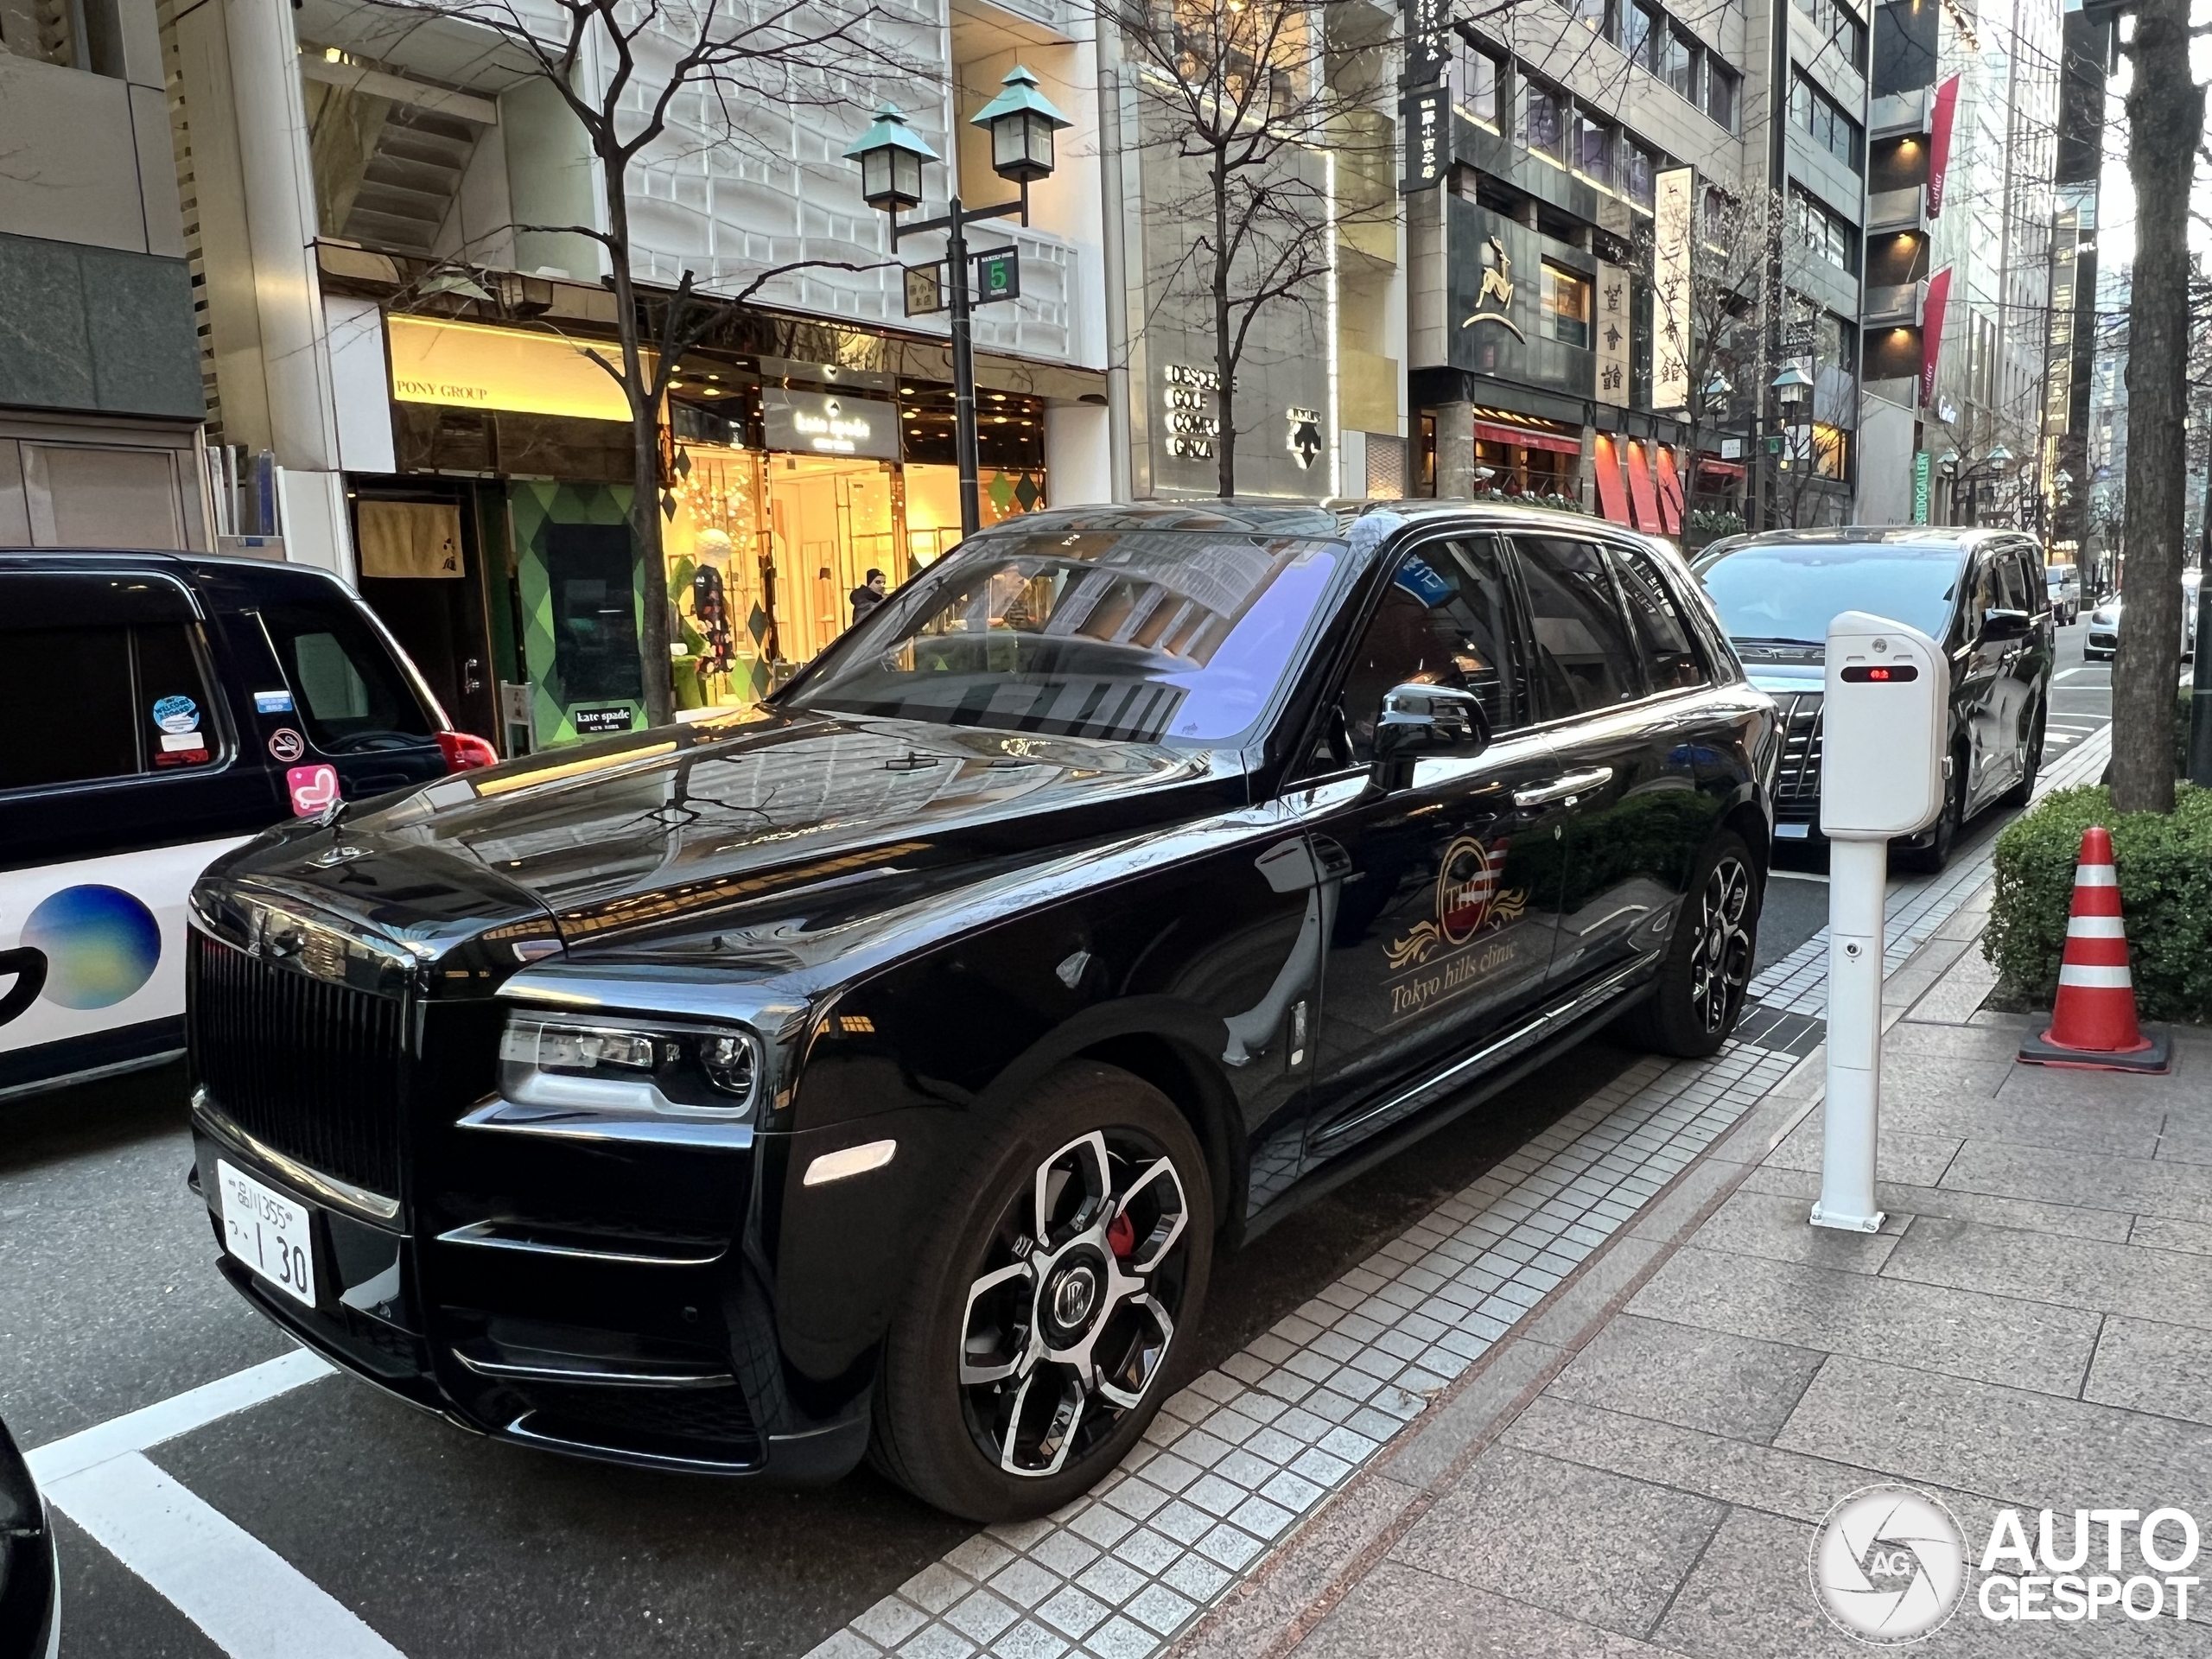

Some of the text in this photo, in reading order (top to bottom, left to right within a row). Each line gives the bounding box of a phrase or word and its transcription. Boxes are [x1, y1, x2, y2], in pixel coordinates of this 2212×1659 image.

[990, 262, 1015, 289] 5
[397, 380, 487, 400] PONY GROUP
[1173, 412, 1220, 437] COMPL
[576, 709, 630, 723] kate spade
[1391, 938, 1518, 1014] Tokyo hills clinic
[263, 1196, 286, 1230] 355
